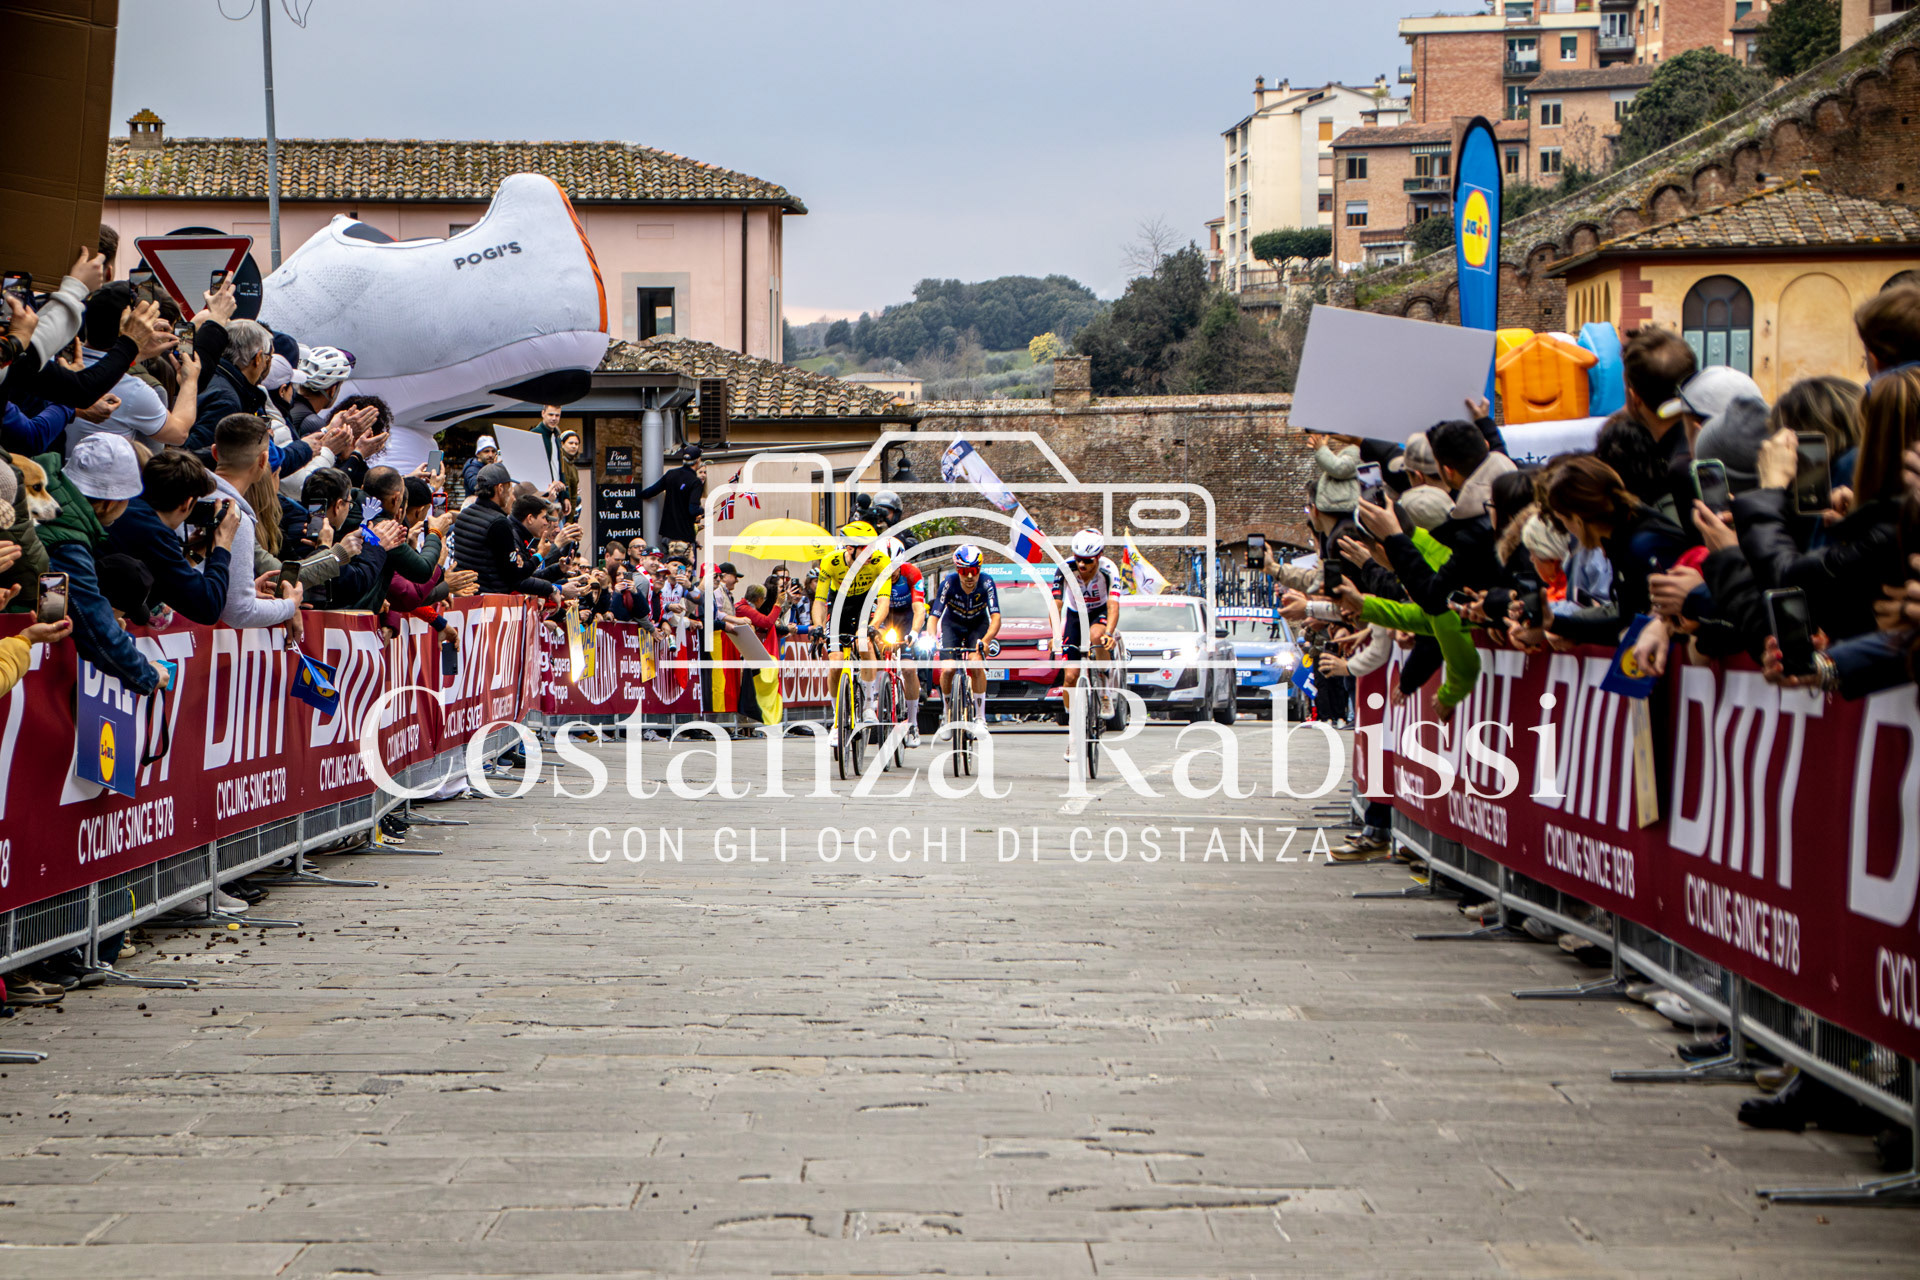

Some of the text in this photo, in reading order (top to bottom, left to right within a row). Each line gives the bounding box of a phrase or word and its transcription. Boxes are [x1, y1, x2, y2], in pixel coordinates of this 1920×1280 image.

[453, 241, 523, 270] POGI'S
[602, 489, 636, 498] Cocktail
[615, 500, 624, 508] &
[599, 511, 641, 520] Wine BAR
[606, 528, 641, 538] Aperitivi
[1215, 607, 1273, 617] HIMANO
[203, 628, 290, 771] DMT
[320, 754, 346, 791] CYCLING
[1668, 664, 1825, 890] DMT
[216, 766, 287, 821] CYCLING SINCE 1978
[77, 796, 174, 865] CYCLING SINCE 1978
[1545, 821, 1635, 900] CYCLING SINCE 1978
[1684, 872, 1801, 976] CYCLING SINCE 1978
